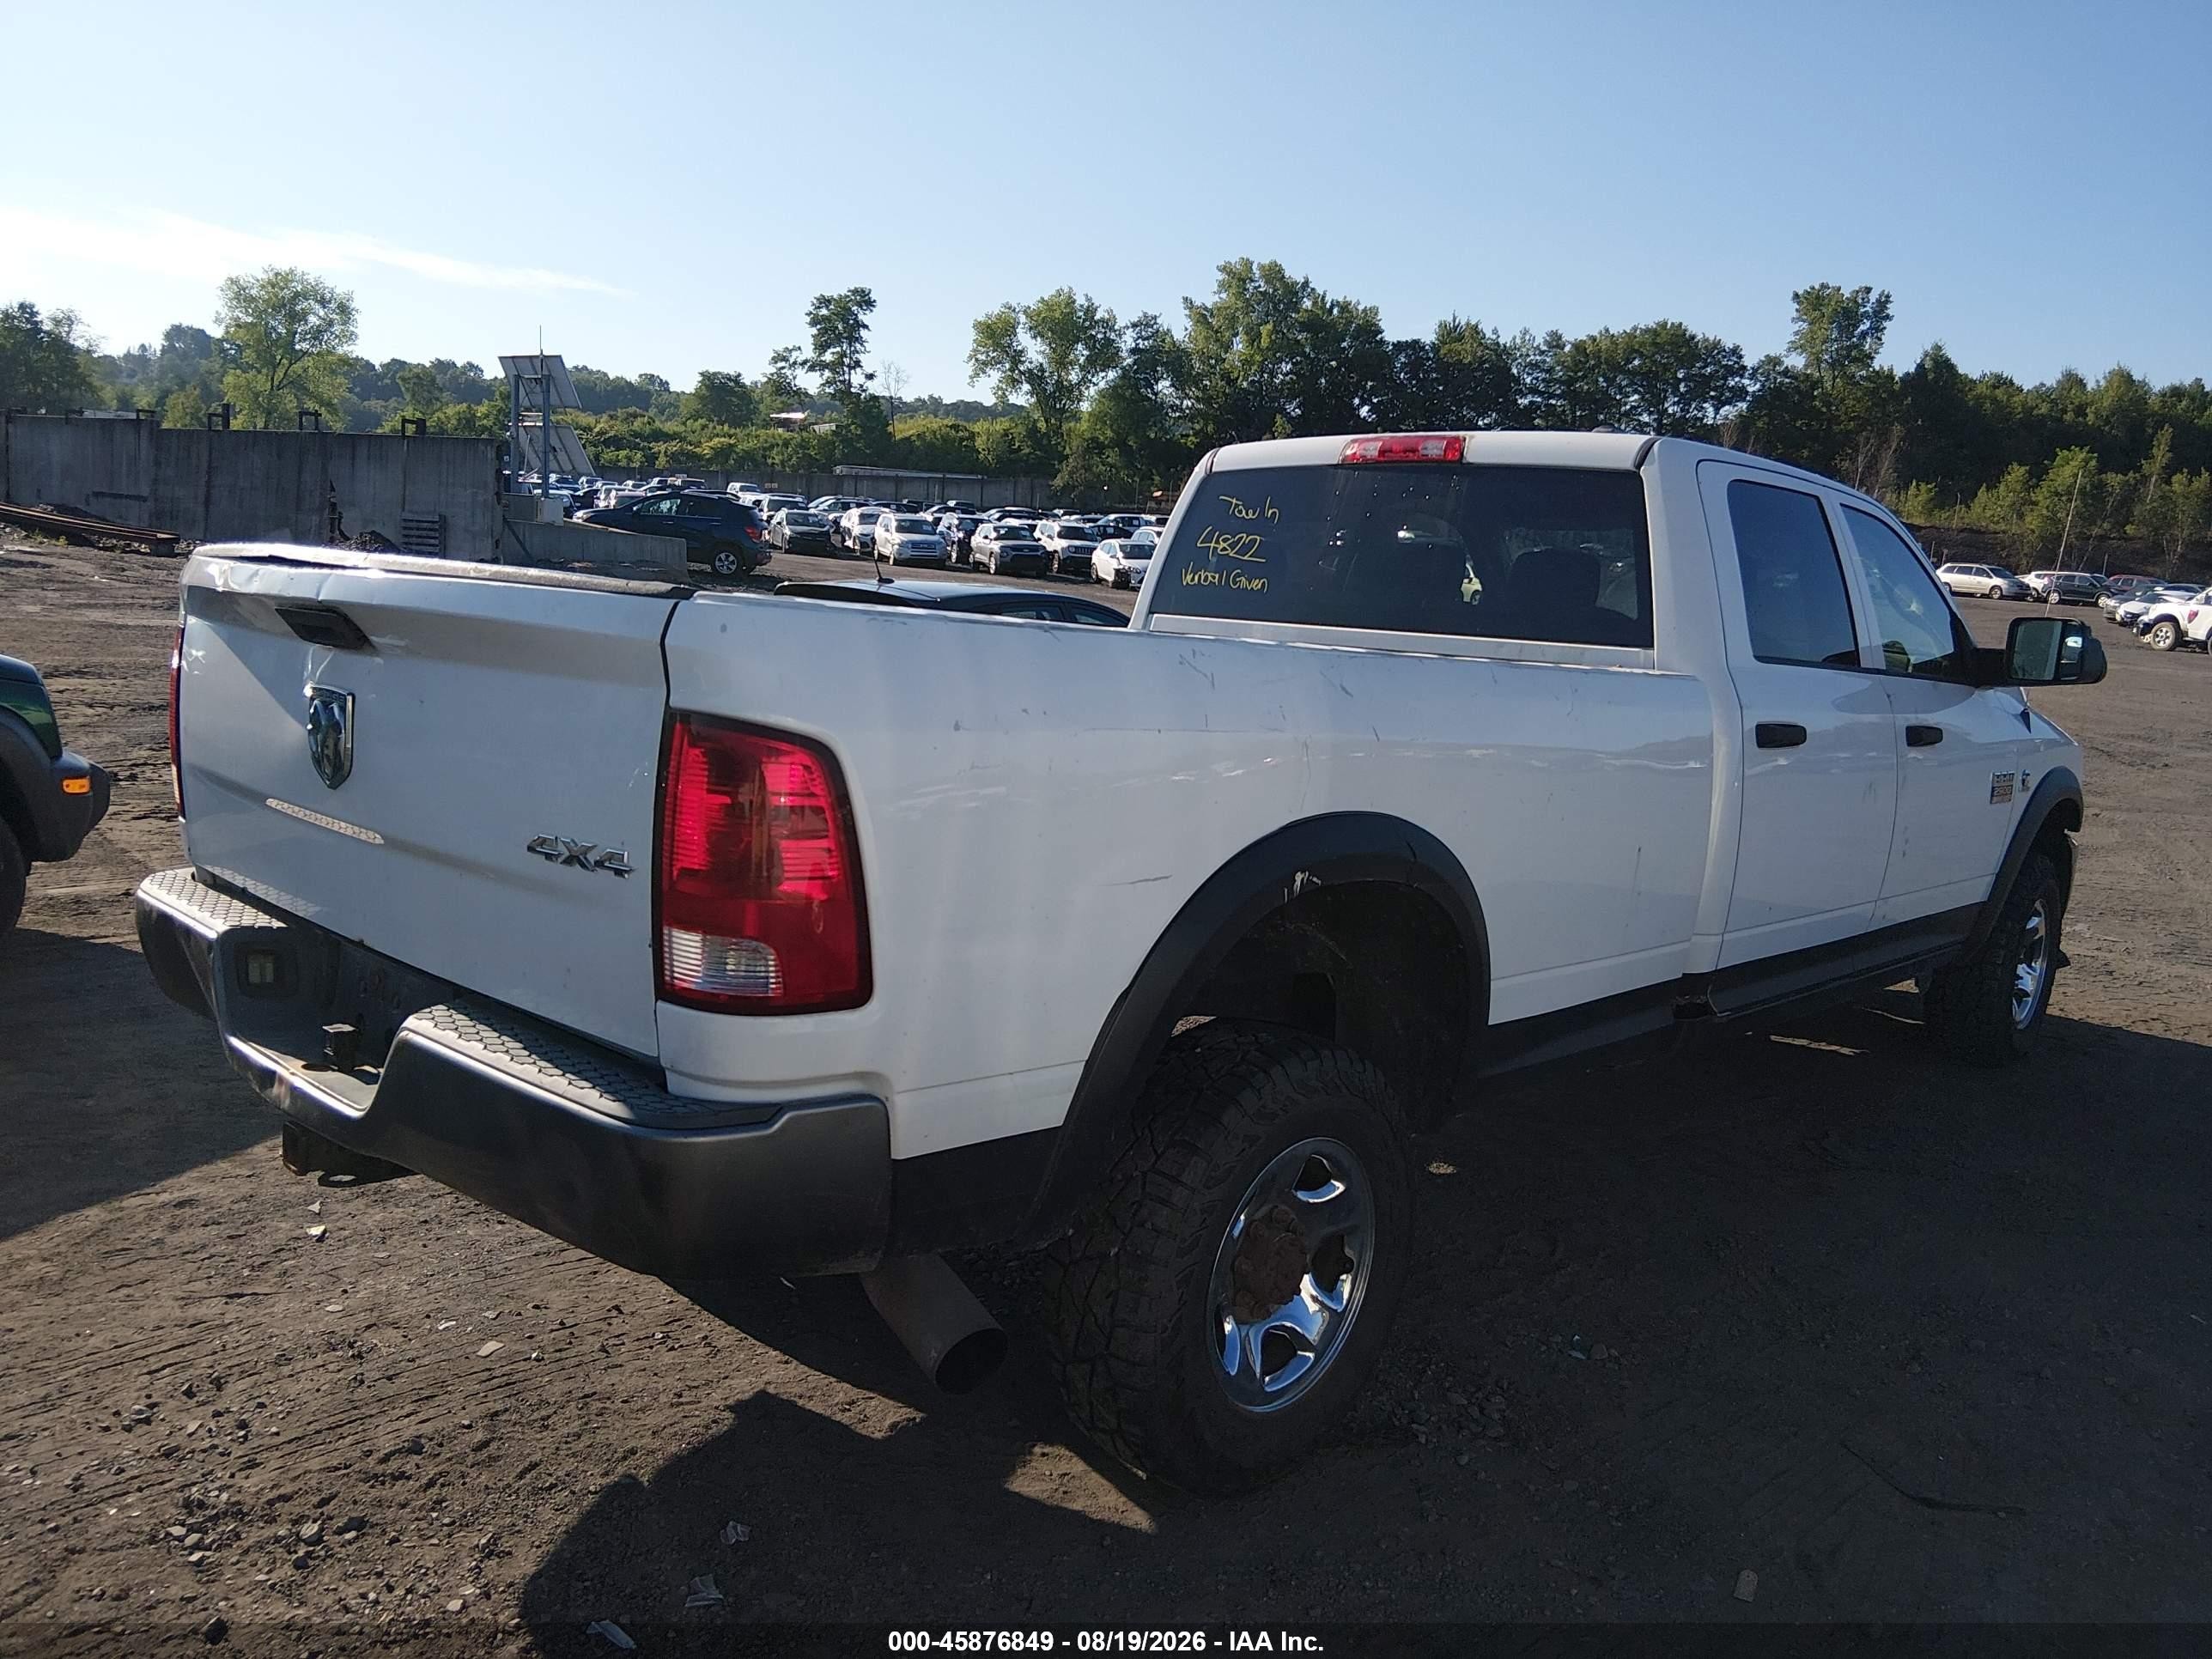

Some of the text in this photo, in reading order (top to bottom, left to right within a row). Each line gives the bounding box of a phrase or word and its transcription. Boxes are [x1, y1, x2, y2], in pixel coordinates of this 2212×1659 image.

[1218, 495, 1279, 524] Tow In
[1196, 525, 1267, 562] 4822
[1181, 561, 1269, 593] Verbal Given
